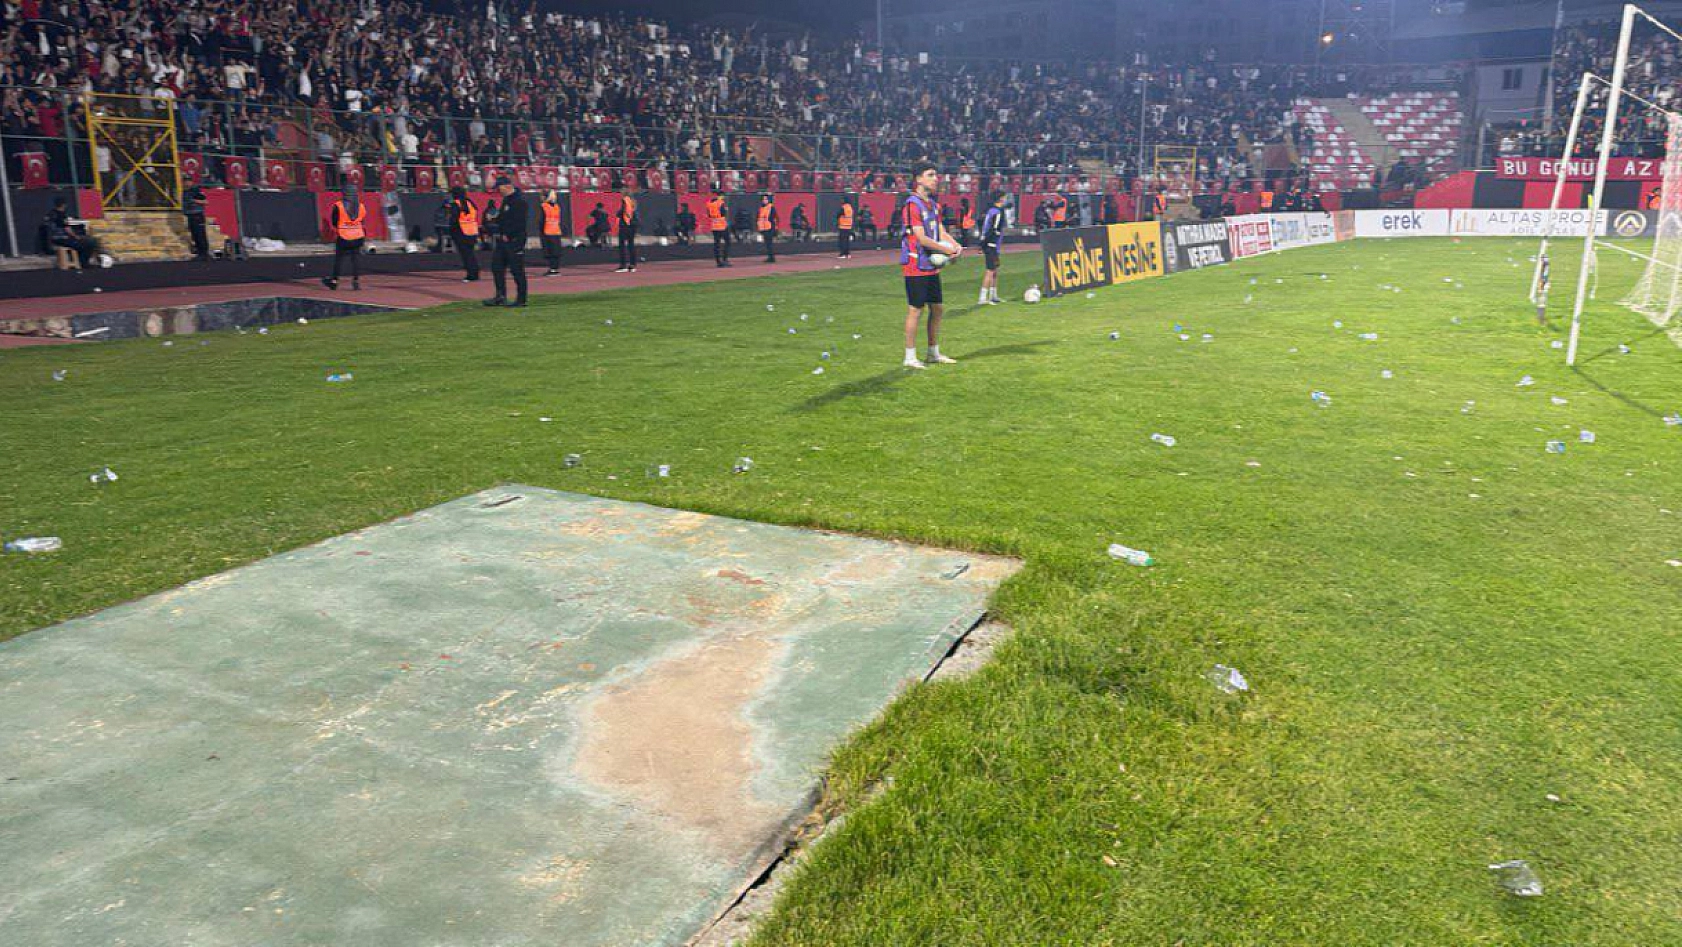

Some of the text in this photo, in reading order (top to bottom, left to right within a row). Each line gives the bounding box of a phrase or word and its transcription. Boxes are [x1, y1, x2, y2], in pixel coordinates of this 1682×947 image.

[1503, 160, 1527, 175] BU
[1623, 160, 1653, 176] AZ
[1382, 210, 1422, 229] erek
